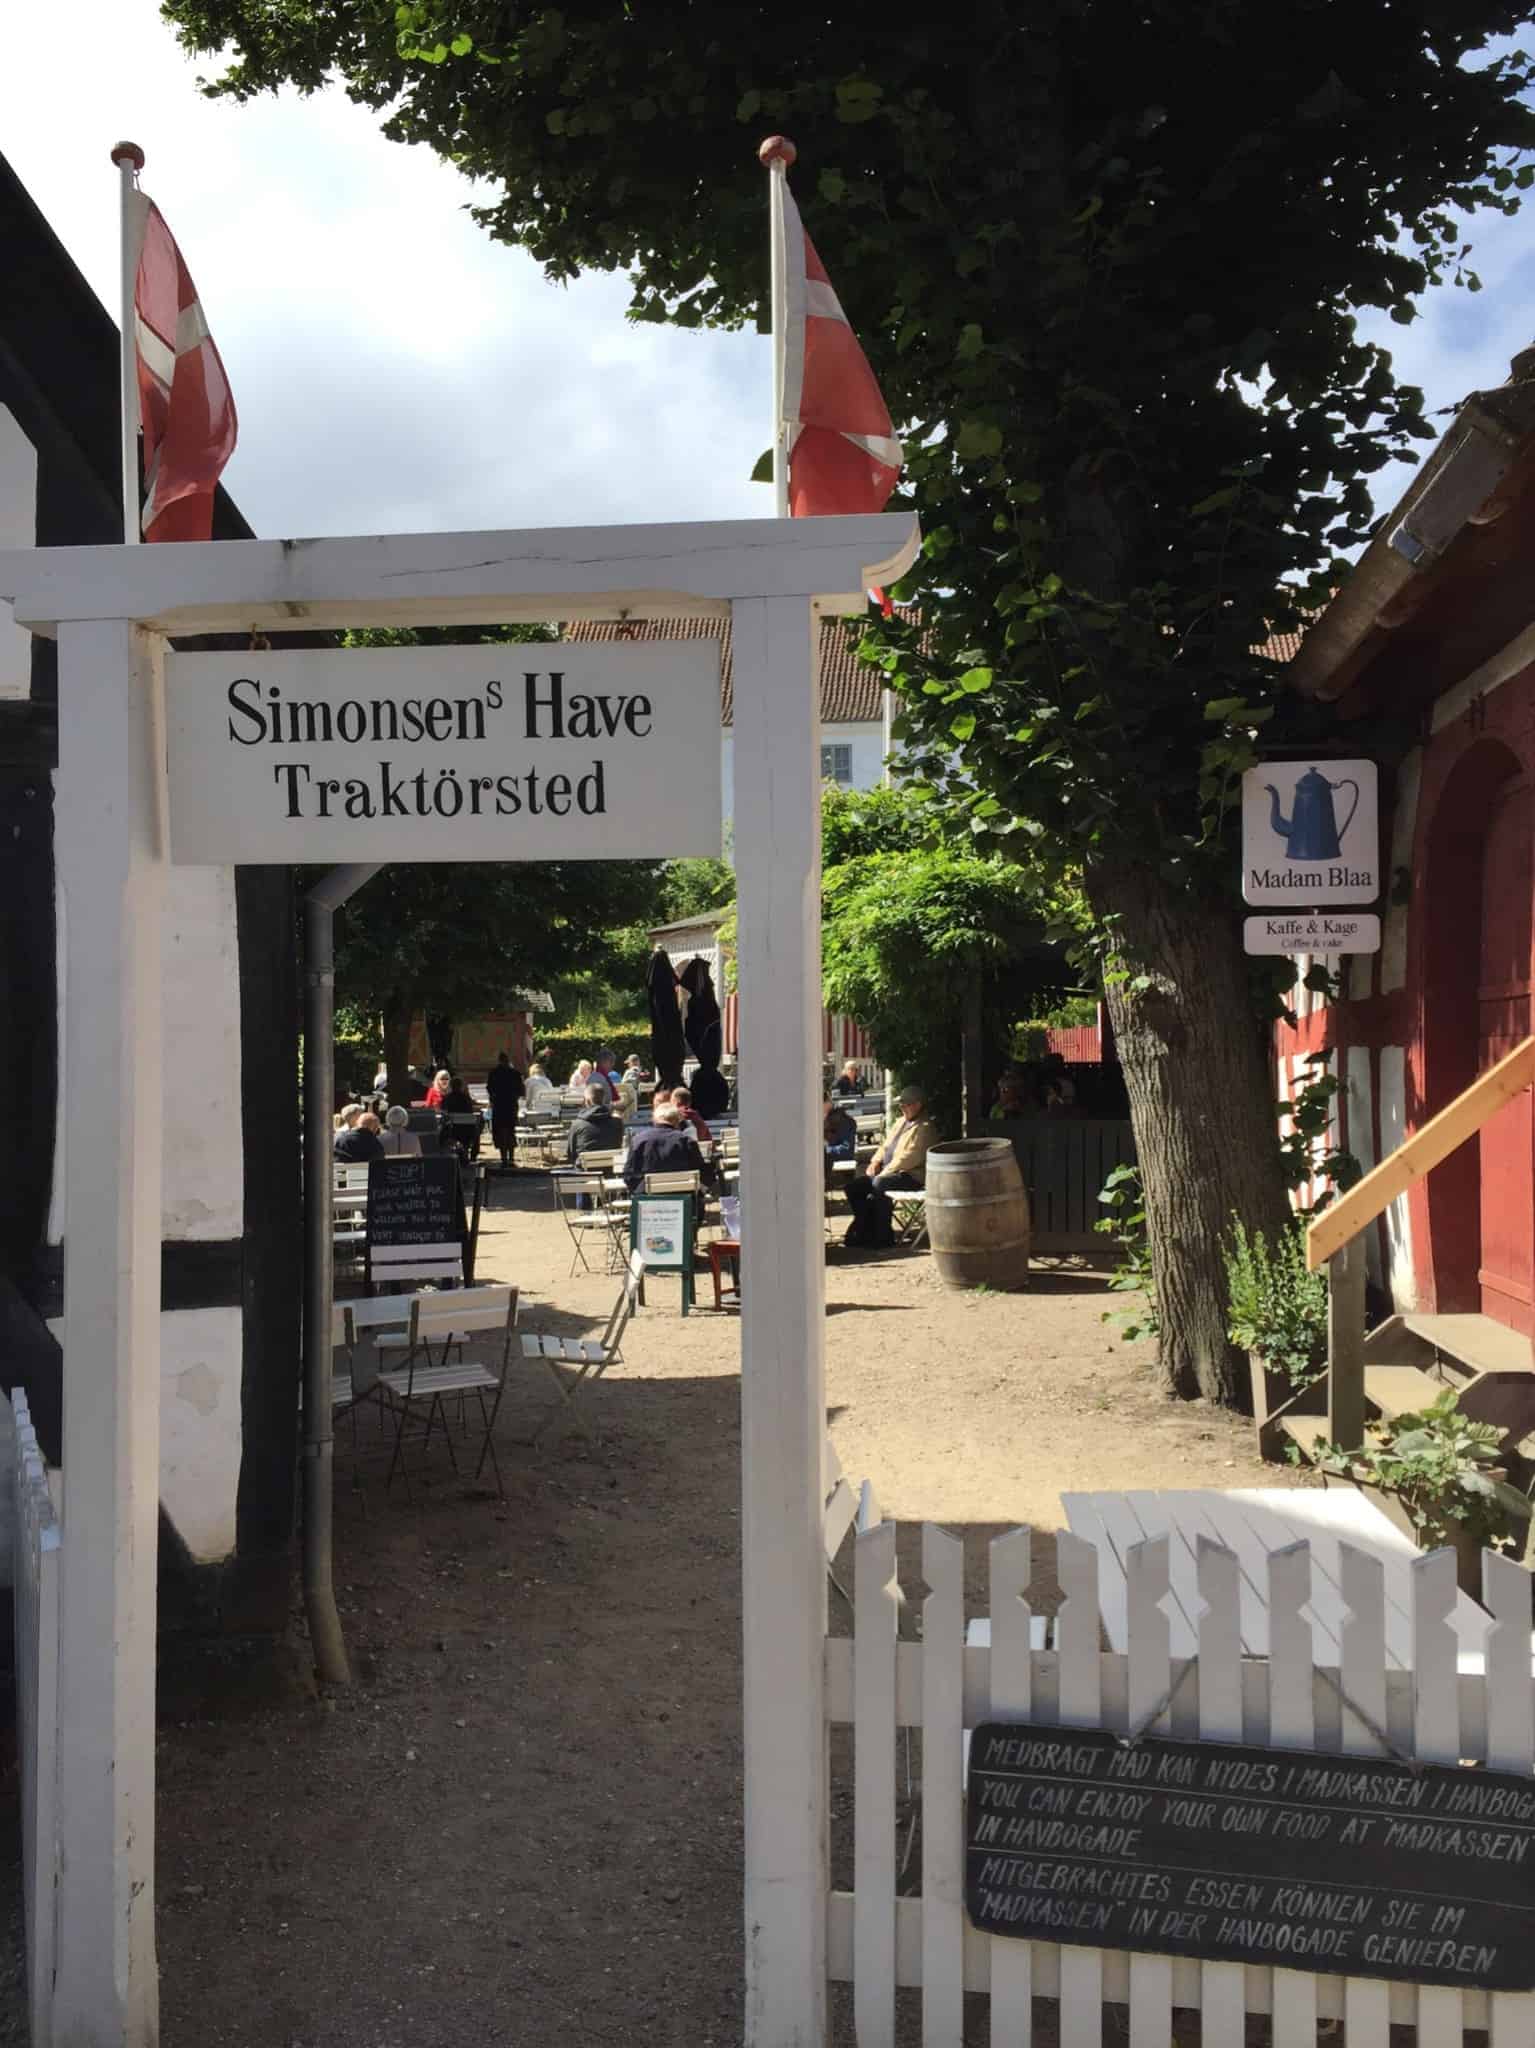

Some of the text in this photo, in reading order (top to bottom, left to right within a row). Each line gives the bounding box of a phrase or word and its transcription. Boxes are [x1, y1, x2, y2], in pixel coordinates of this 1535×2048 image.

[522, 672, 652, 738] Have
[273, 760, 607, 820] Traktörsted
[1251, 867, 1372, 889] Madam Blaa
[1266, 920, 1358, 937] Kaffe & Kage
[984, 1737, 1103, 1776] MEDBRAGT
[1107, 1751, 1152, 1779] MAD
[1156, 1754, 1200, 1785] KAN
[1205, 1760, 1279, 1791] NYDES
[1296, 1768, 1429, 1808] MADKASSEN
[975, 1814, 1143, 1856] IN HAVBOGADE
[979, 1779, 1024, 1808] YOU
[1027, 1786, 1073, 1815] CAN
[1075, 1790, 1152, 1822] ENJOY
[1160, 1799, 1216, 1829] YOUR
[1221, 1804, 1270, 1833] OWN
[1272, 1810, 1331, 1839] FOOD
[1339, 1818, 1376, 1846] AT
[978, 1856, 1466, 1935] MITGEBRACHTES ESSEN KÖNNEN SIE IM
[1128, 1907, 1158, 1934] IN
[1160, 1911, 1208, 1940] DER
[1216, 1917, 1355, 1957] HAVBOGADE
